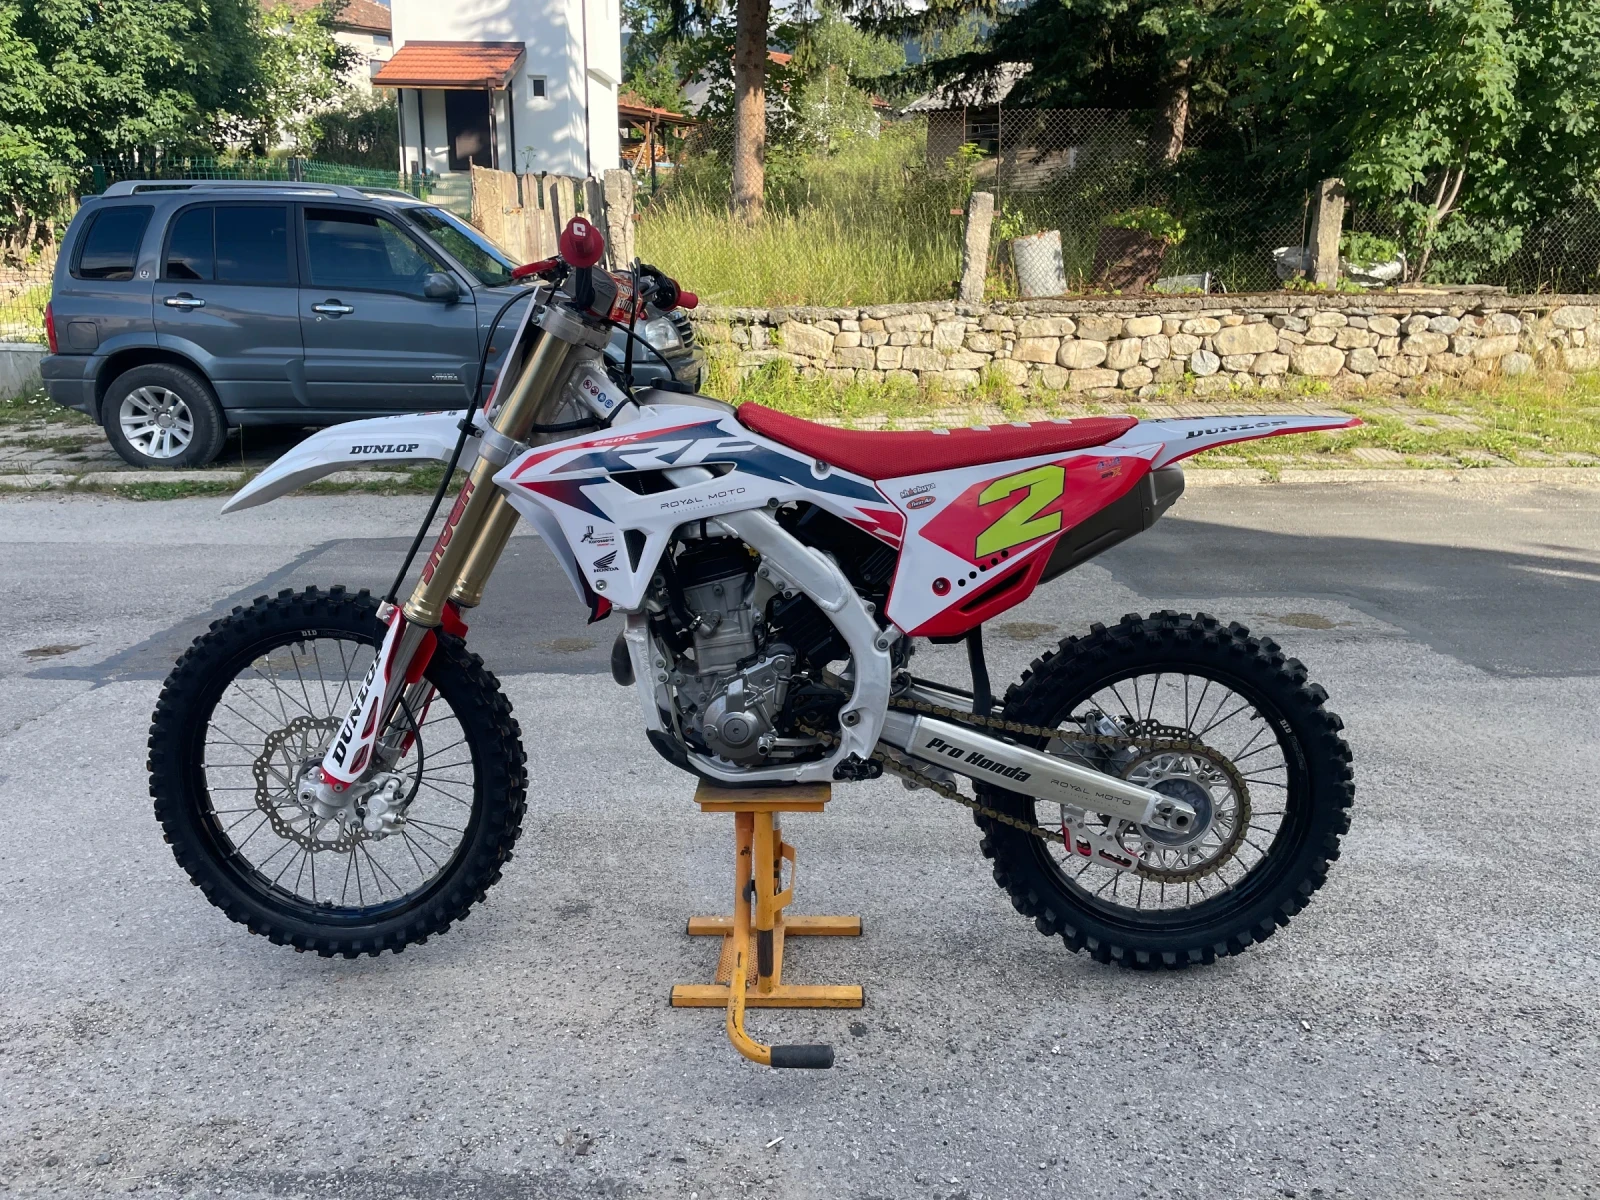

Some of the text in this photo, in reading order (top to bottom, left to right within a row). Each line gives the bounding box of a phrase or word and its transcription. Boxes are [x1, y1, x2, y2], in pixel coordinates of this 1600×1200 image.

[592, 434, 639, 446] 250R
[1185, 420, 1288, 440] DUNLOP
[349, 443, 419, 454] DUNLOP
[660, 497, 703, 510] ROYAL
[708, 487, 746, 500] MOTO
[975, 463, 1067, 560] 2
[925, 737, 1032, 783] Pro Honda
[1050, 778, 1090, 795] ROYAL
[1095, 791, 1131, 806] MOTO
